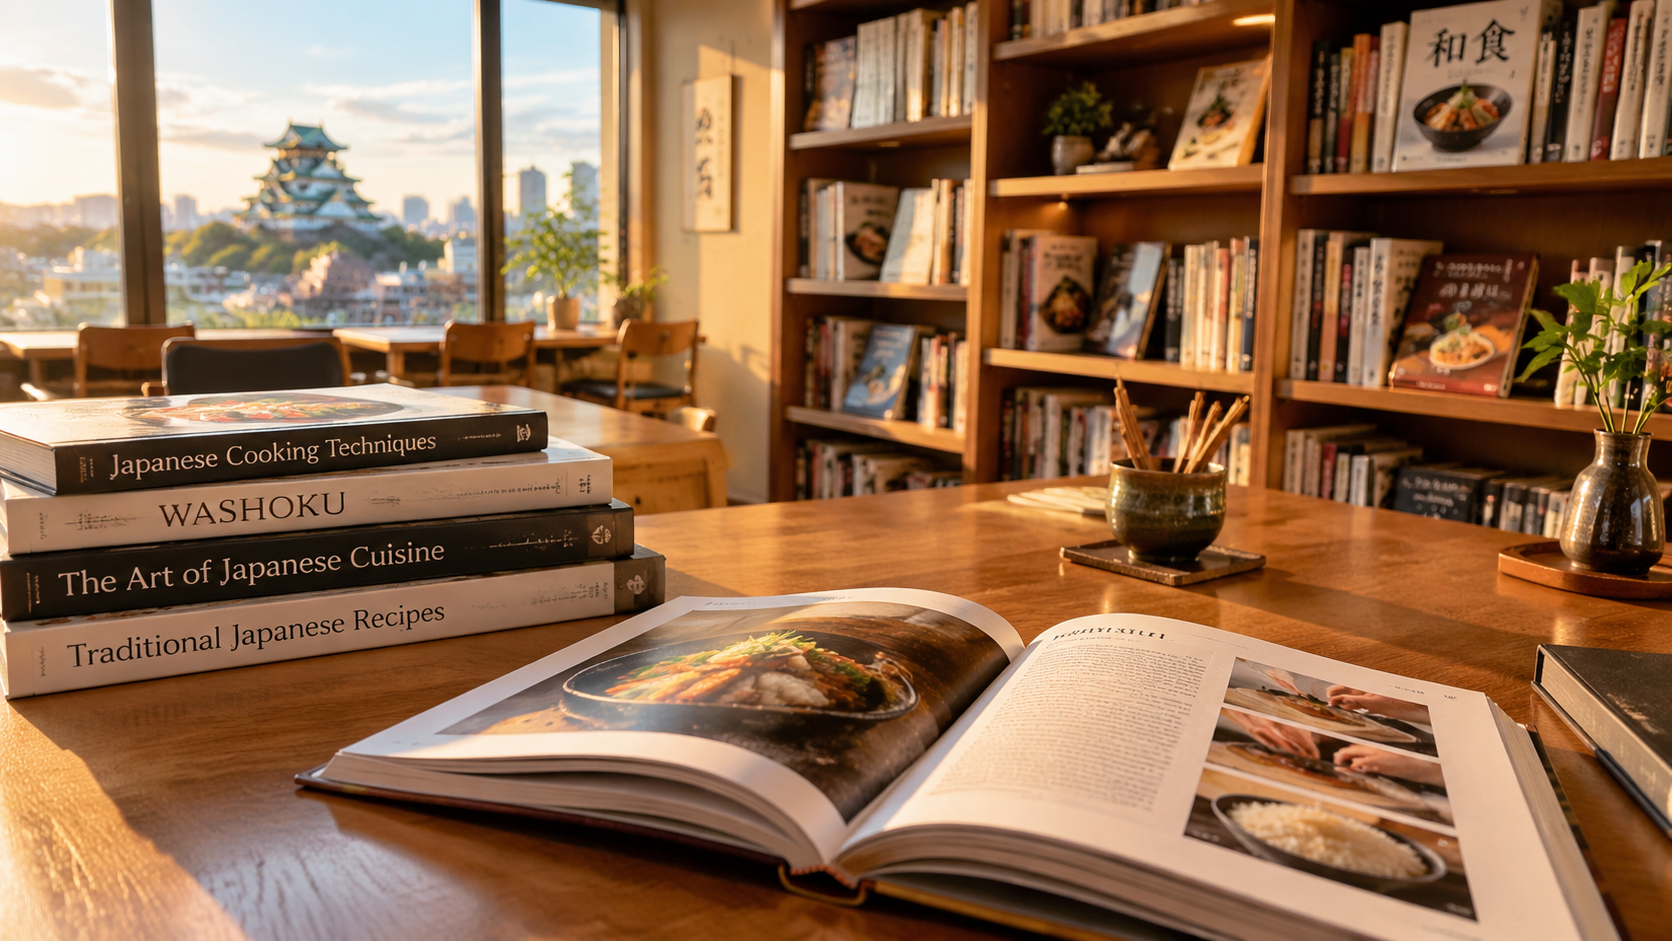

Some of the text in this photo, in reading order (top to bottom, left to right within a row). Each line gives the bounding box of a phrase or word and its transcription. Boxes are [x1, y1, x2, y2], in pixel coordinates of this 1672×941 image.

[1425, 19, 1515, 68] 和食
[110, 453, 218, 480] Japanese
[226, 441, 320, 466] Cooking
[325, 434, 436, 457] Techniques
[158, 491, 345, 527] WASHOKU
[58, 541, 445, 596] The Art of Japanese Cuisine
[67, 605, 445, 667] Traditional Japanese Recipes
